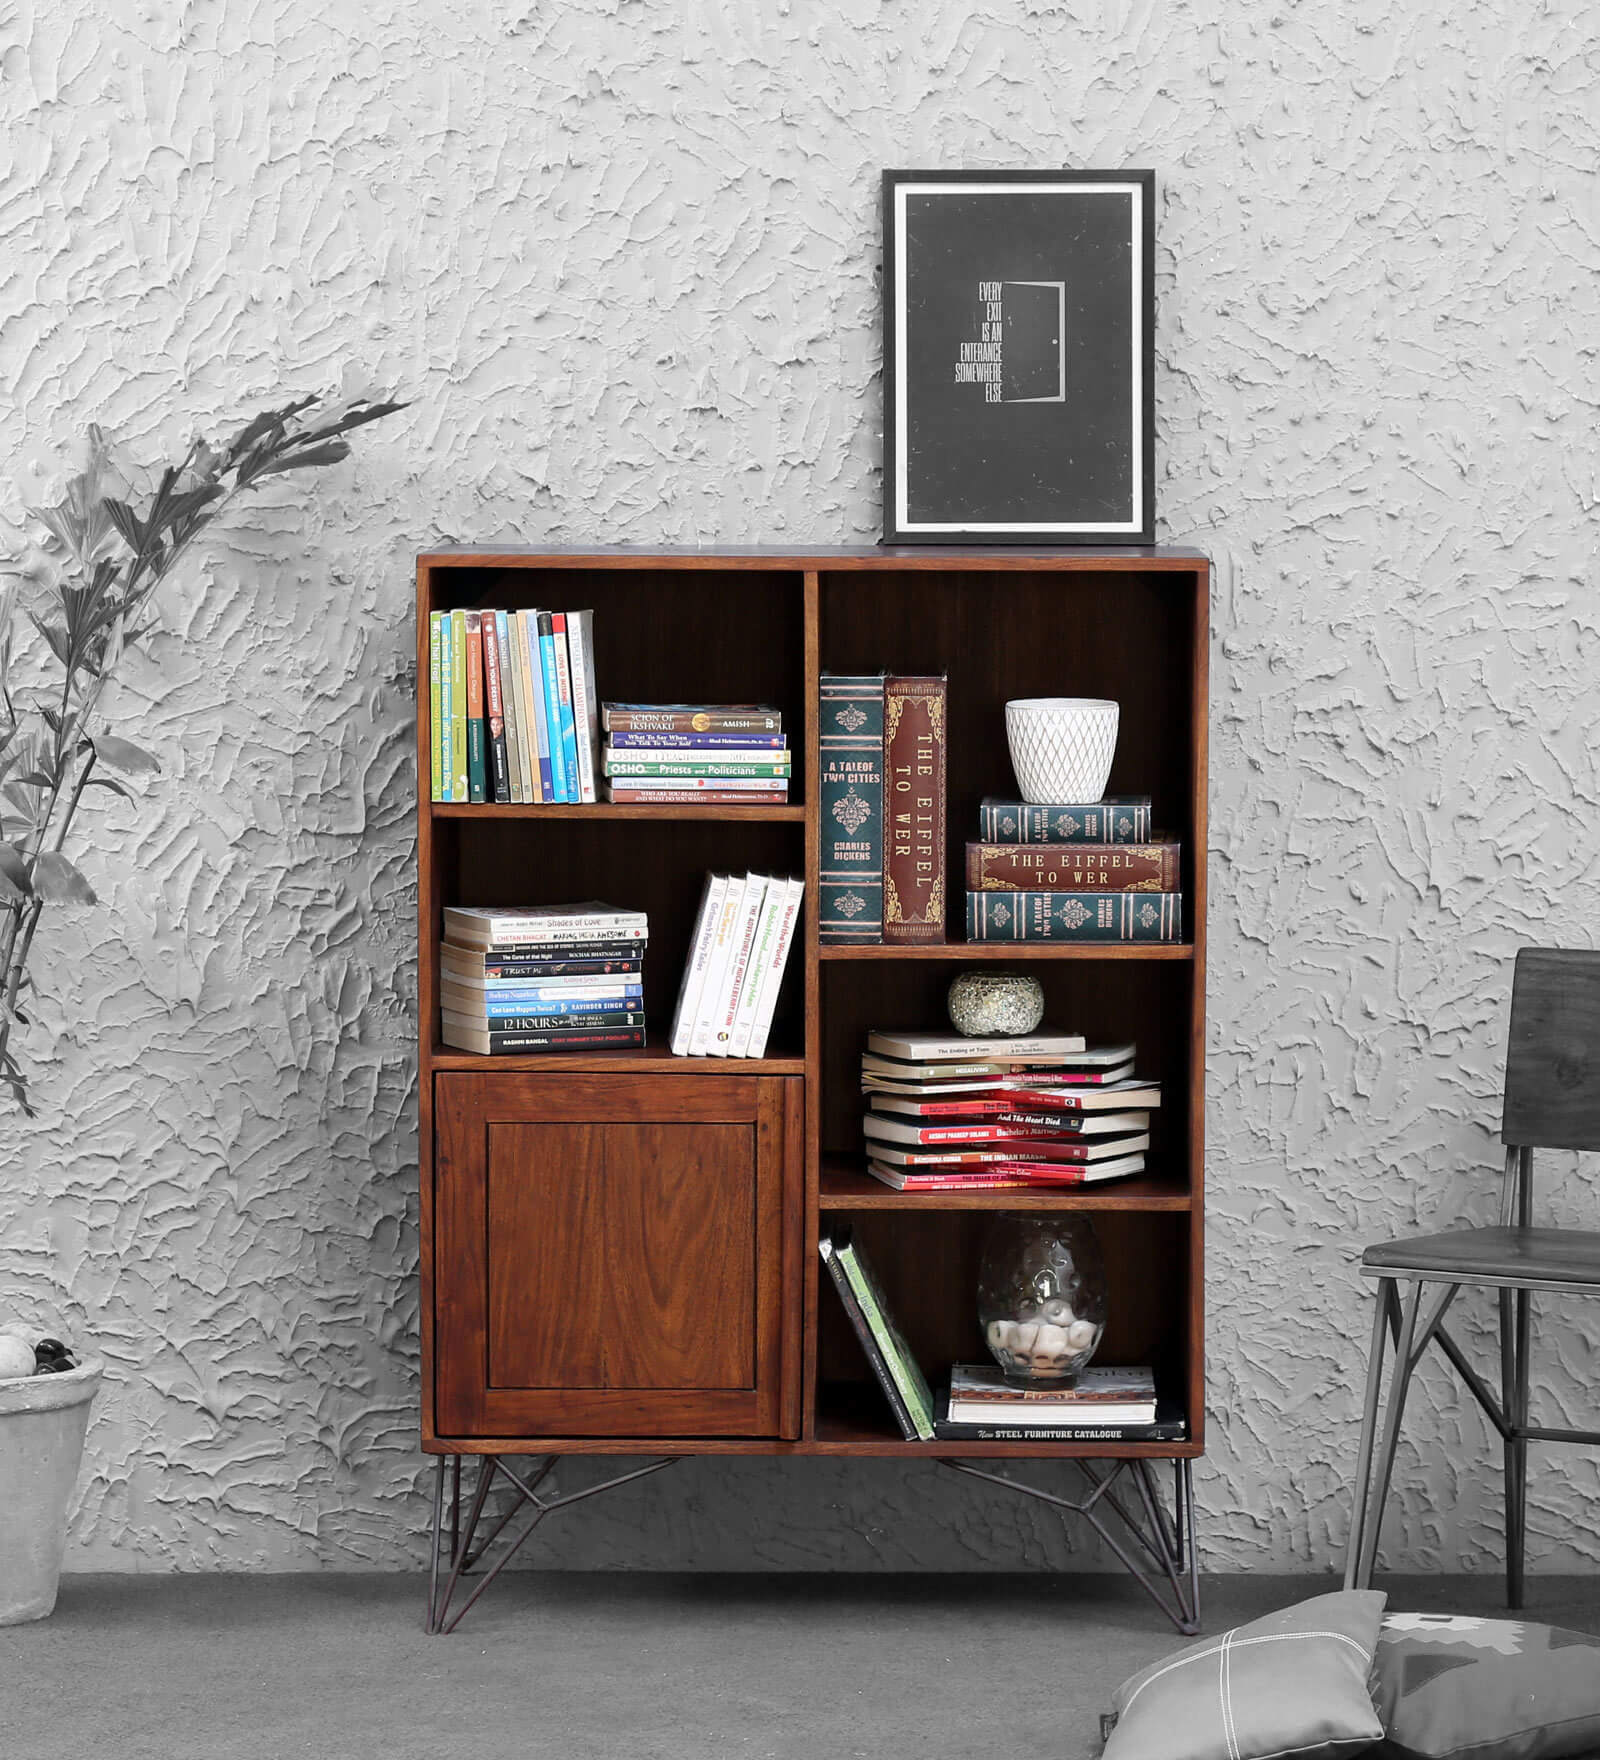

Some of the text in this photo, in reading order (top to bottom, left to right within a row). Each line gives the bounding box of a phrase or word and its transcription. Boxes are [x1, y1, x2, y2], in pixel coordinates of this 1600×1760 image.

[979, 281, 1002, 301] EVERY
[987, 302, 1002, 321] EXIT
[982, 322, 1002, 341] IS AN
[960, 342, 1002, 362] ENTERANCE
[955, 362, 1002, 382] SOMEWHERE
[986, 382, 1002, 402] ELSE
[432, 642, 441, 660] That
[490, 668, 498, 685] YOUR
[576, 676, 586, 729] CHAMPIONS
[630, 721, 675, 730] IKSHVAKU
[722, 720, 750, 728] AMISH
[612, 750, 649, 761] OSHO
[610, 764, 646, 774] OSHO
[659, 764, 692, 775] Priests
[708, 764, 757, 775] Politicians
[830, 762, 837, 772] A
[848, 772, 881, 784] CITIES
[896, 766, 912, 856] TO WER
[916, 734, 933, 888] THE EIFFEL
[834, 842, 871, 851] CHARLES
[834, 852, 871, 861] DICKENS
[1010, 854, 1135, 868] THE EIFFEL
[1036, 872, 1109, 884] TO WER
[749, 905, 759, 916] THE
[1043, 892, 1052, 918] CITIES
[547, 918, 573, 928] Shades
[496, 934, 521, 942] CHETAN
[597, 930, 628, 939] AWESOME
[740, 918, 756, 957] ADVENTURES
[760, 928, 774, 951] Hood
[774, 904, 795, 969] War of the Worlds
[700, 933, 712, 951] Fairy
[738, 958, 746, 966] OF
[729, 966, 744, 1011] HUCKLEBERRY
[572, 1002, 602, 1010] RAVINDER
[504, 1019, 514, 1030] 12
[516, 1017, 559, 1029] HOURS
[725, 1012, 735, 1027] FINN
[1012, 1114, 1024, 1122] The
[1044, 1118, 1061, 1126] Died
[996, 1128, 1029, 1137] Bachelor's
[860, 1295, 873, 1318] India
[995, 1430, 1023, 1438] STEEL
[1024, 1430, 1073, 1438] FURNITURE
[1074, 1430, 1122, 1438] CATALOGUE
